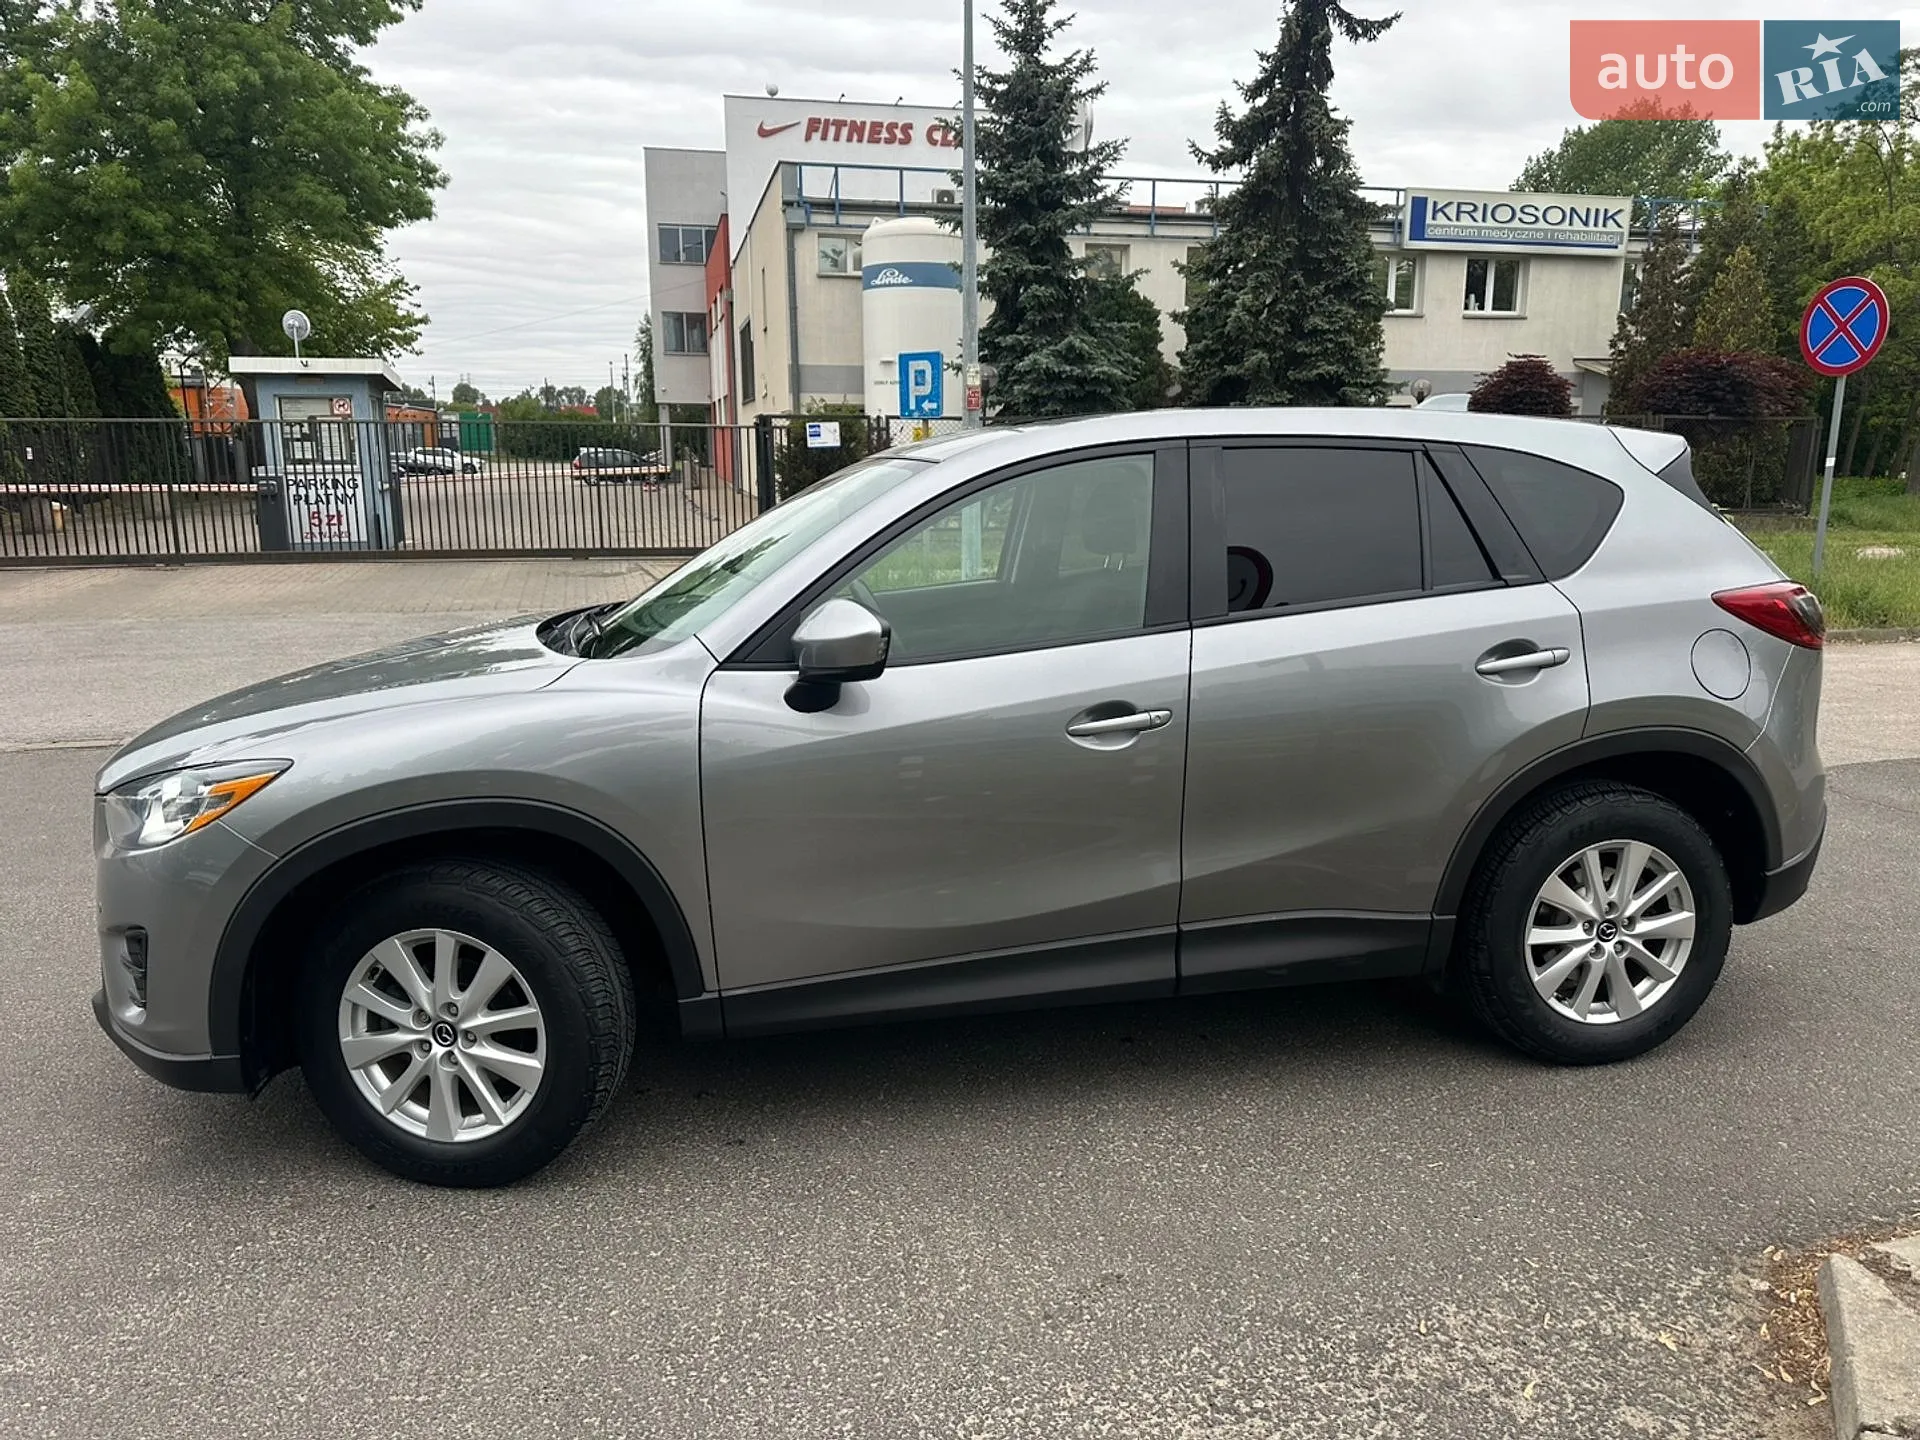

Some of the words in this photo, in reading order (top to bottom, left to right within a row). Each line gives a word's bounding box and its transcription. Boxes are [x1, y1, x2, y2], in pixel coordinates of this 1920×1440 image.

[804, 117, 913, 145] FITNESS
[1430, 200, 1624, 229] KRIOSONIK
[1427, 226, 1478, 237] centrum
[1481, 229, 1544, 240] medyczne
[1554, 231, 1620, 243] rehabilitacji
[870, 268, 913, 285] Linde
[908, 360, 932, 410] P
[286, 478, 359, 490] PARKING
[311, 511, 322, 527] 5
